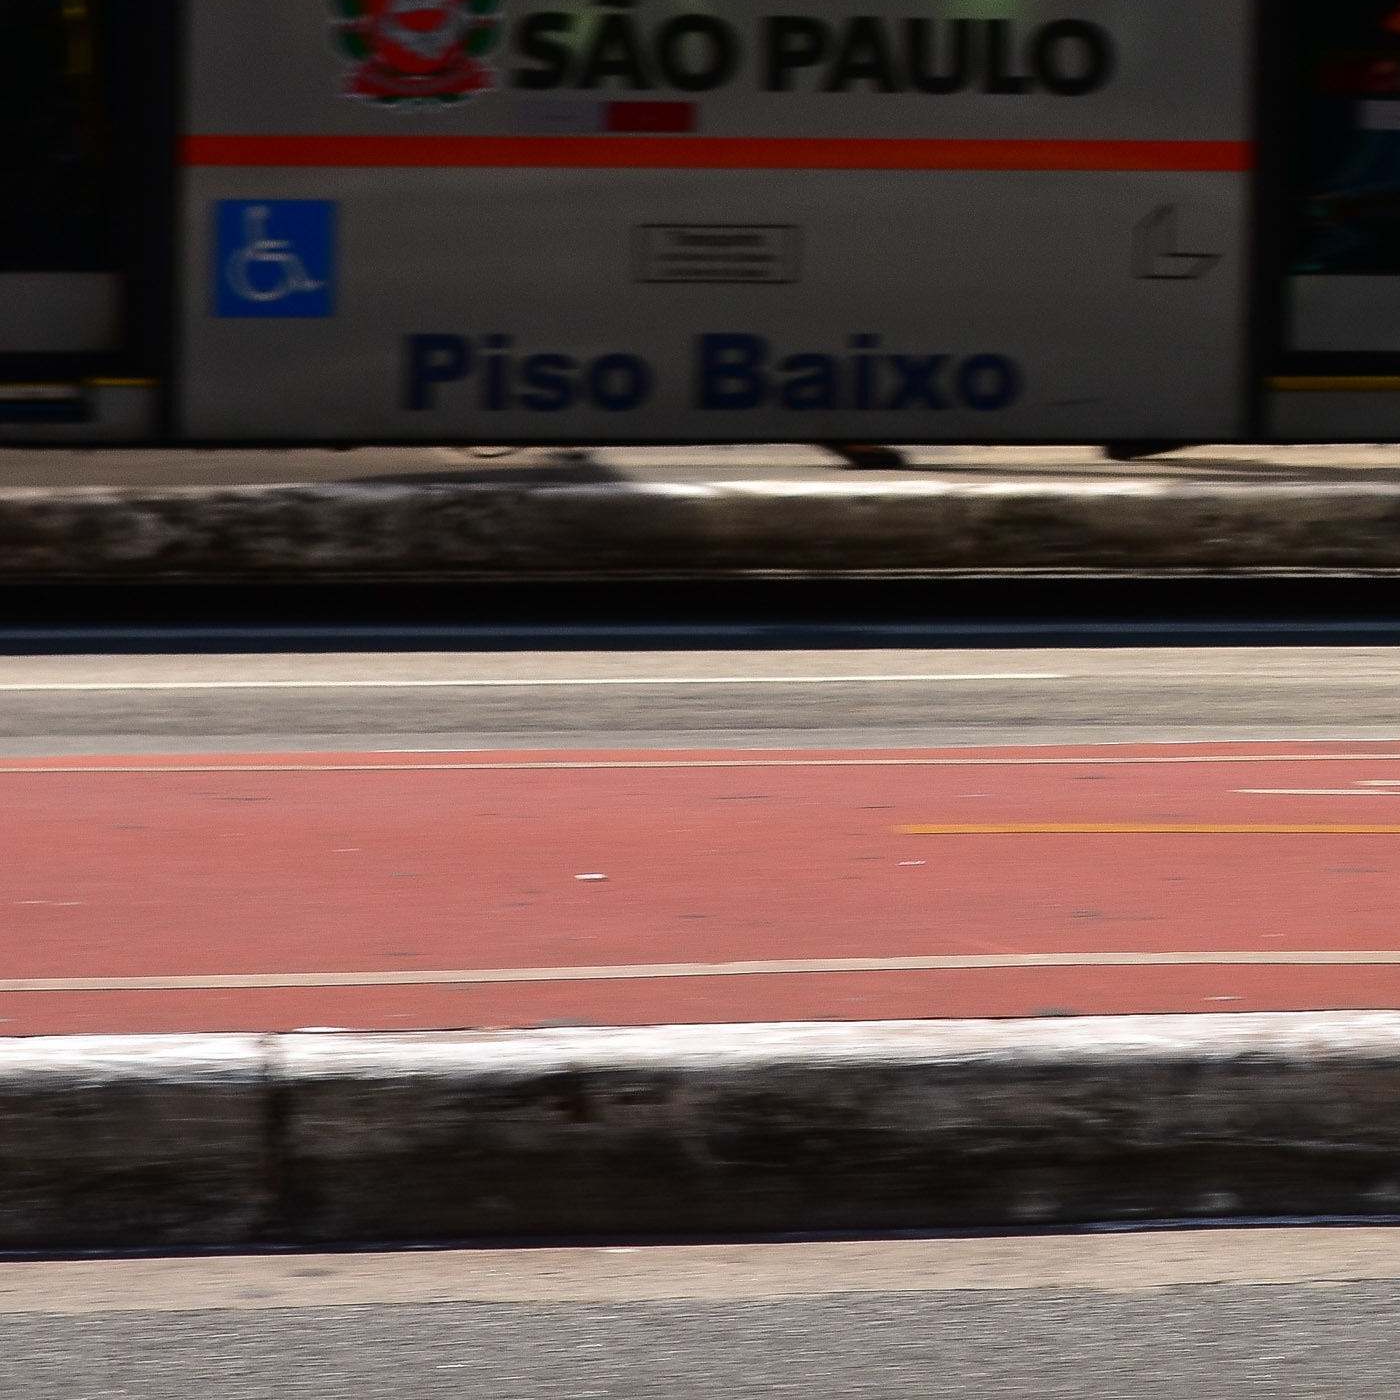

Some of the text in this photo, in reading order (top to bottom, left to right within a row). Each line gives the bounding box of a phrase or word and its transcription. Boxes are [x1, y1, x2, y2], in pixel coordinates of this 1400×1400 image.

[762, 14, 1112, 97] PAULO
[402, 331, 1022, 412] Piso Baixo
